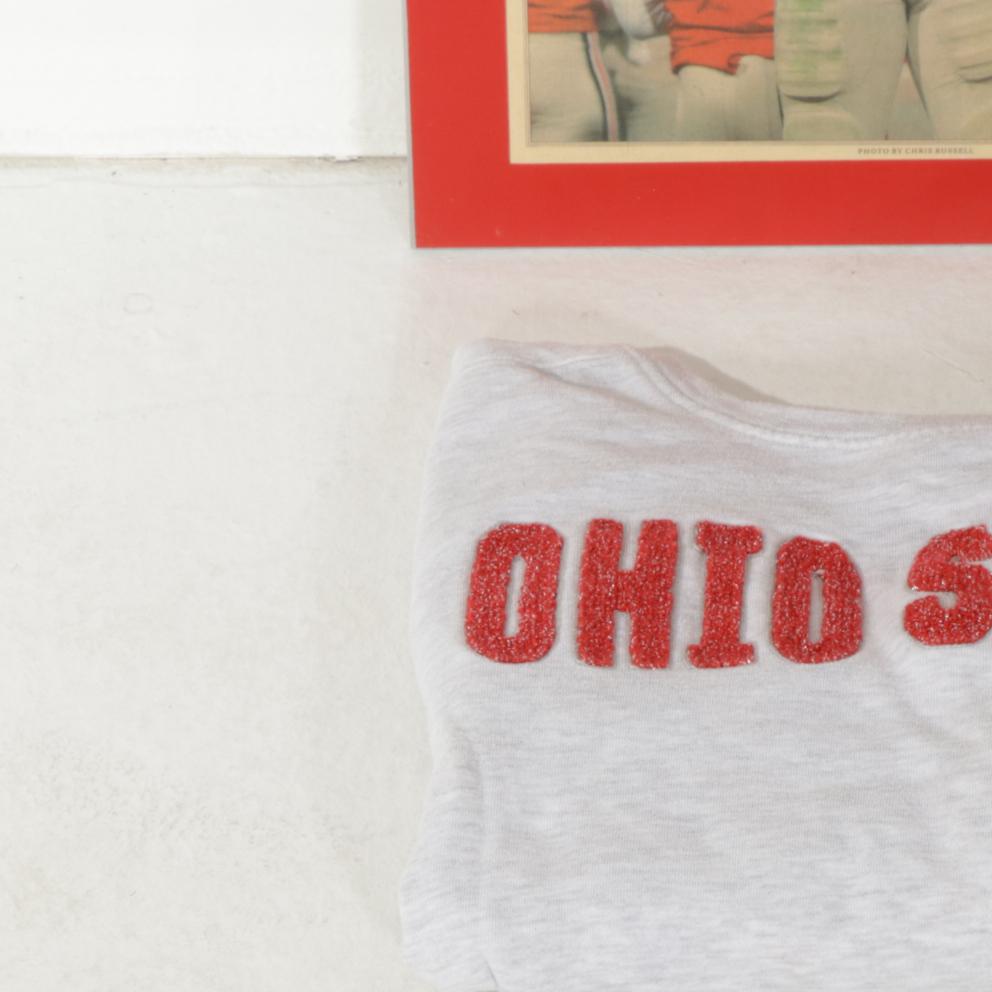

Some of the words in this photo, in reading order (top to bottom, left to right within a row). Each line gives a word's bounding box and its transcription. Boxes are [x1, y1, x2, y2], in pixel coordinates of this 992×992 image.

[857, 147, 890, 155] PHOTO
[891, 147, 903, 155] BY
[904, 147, 934, 155] CHRIS
[935, 146, 975, 155] RUSSELL
[465, 517, 864, 670] OHIO
